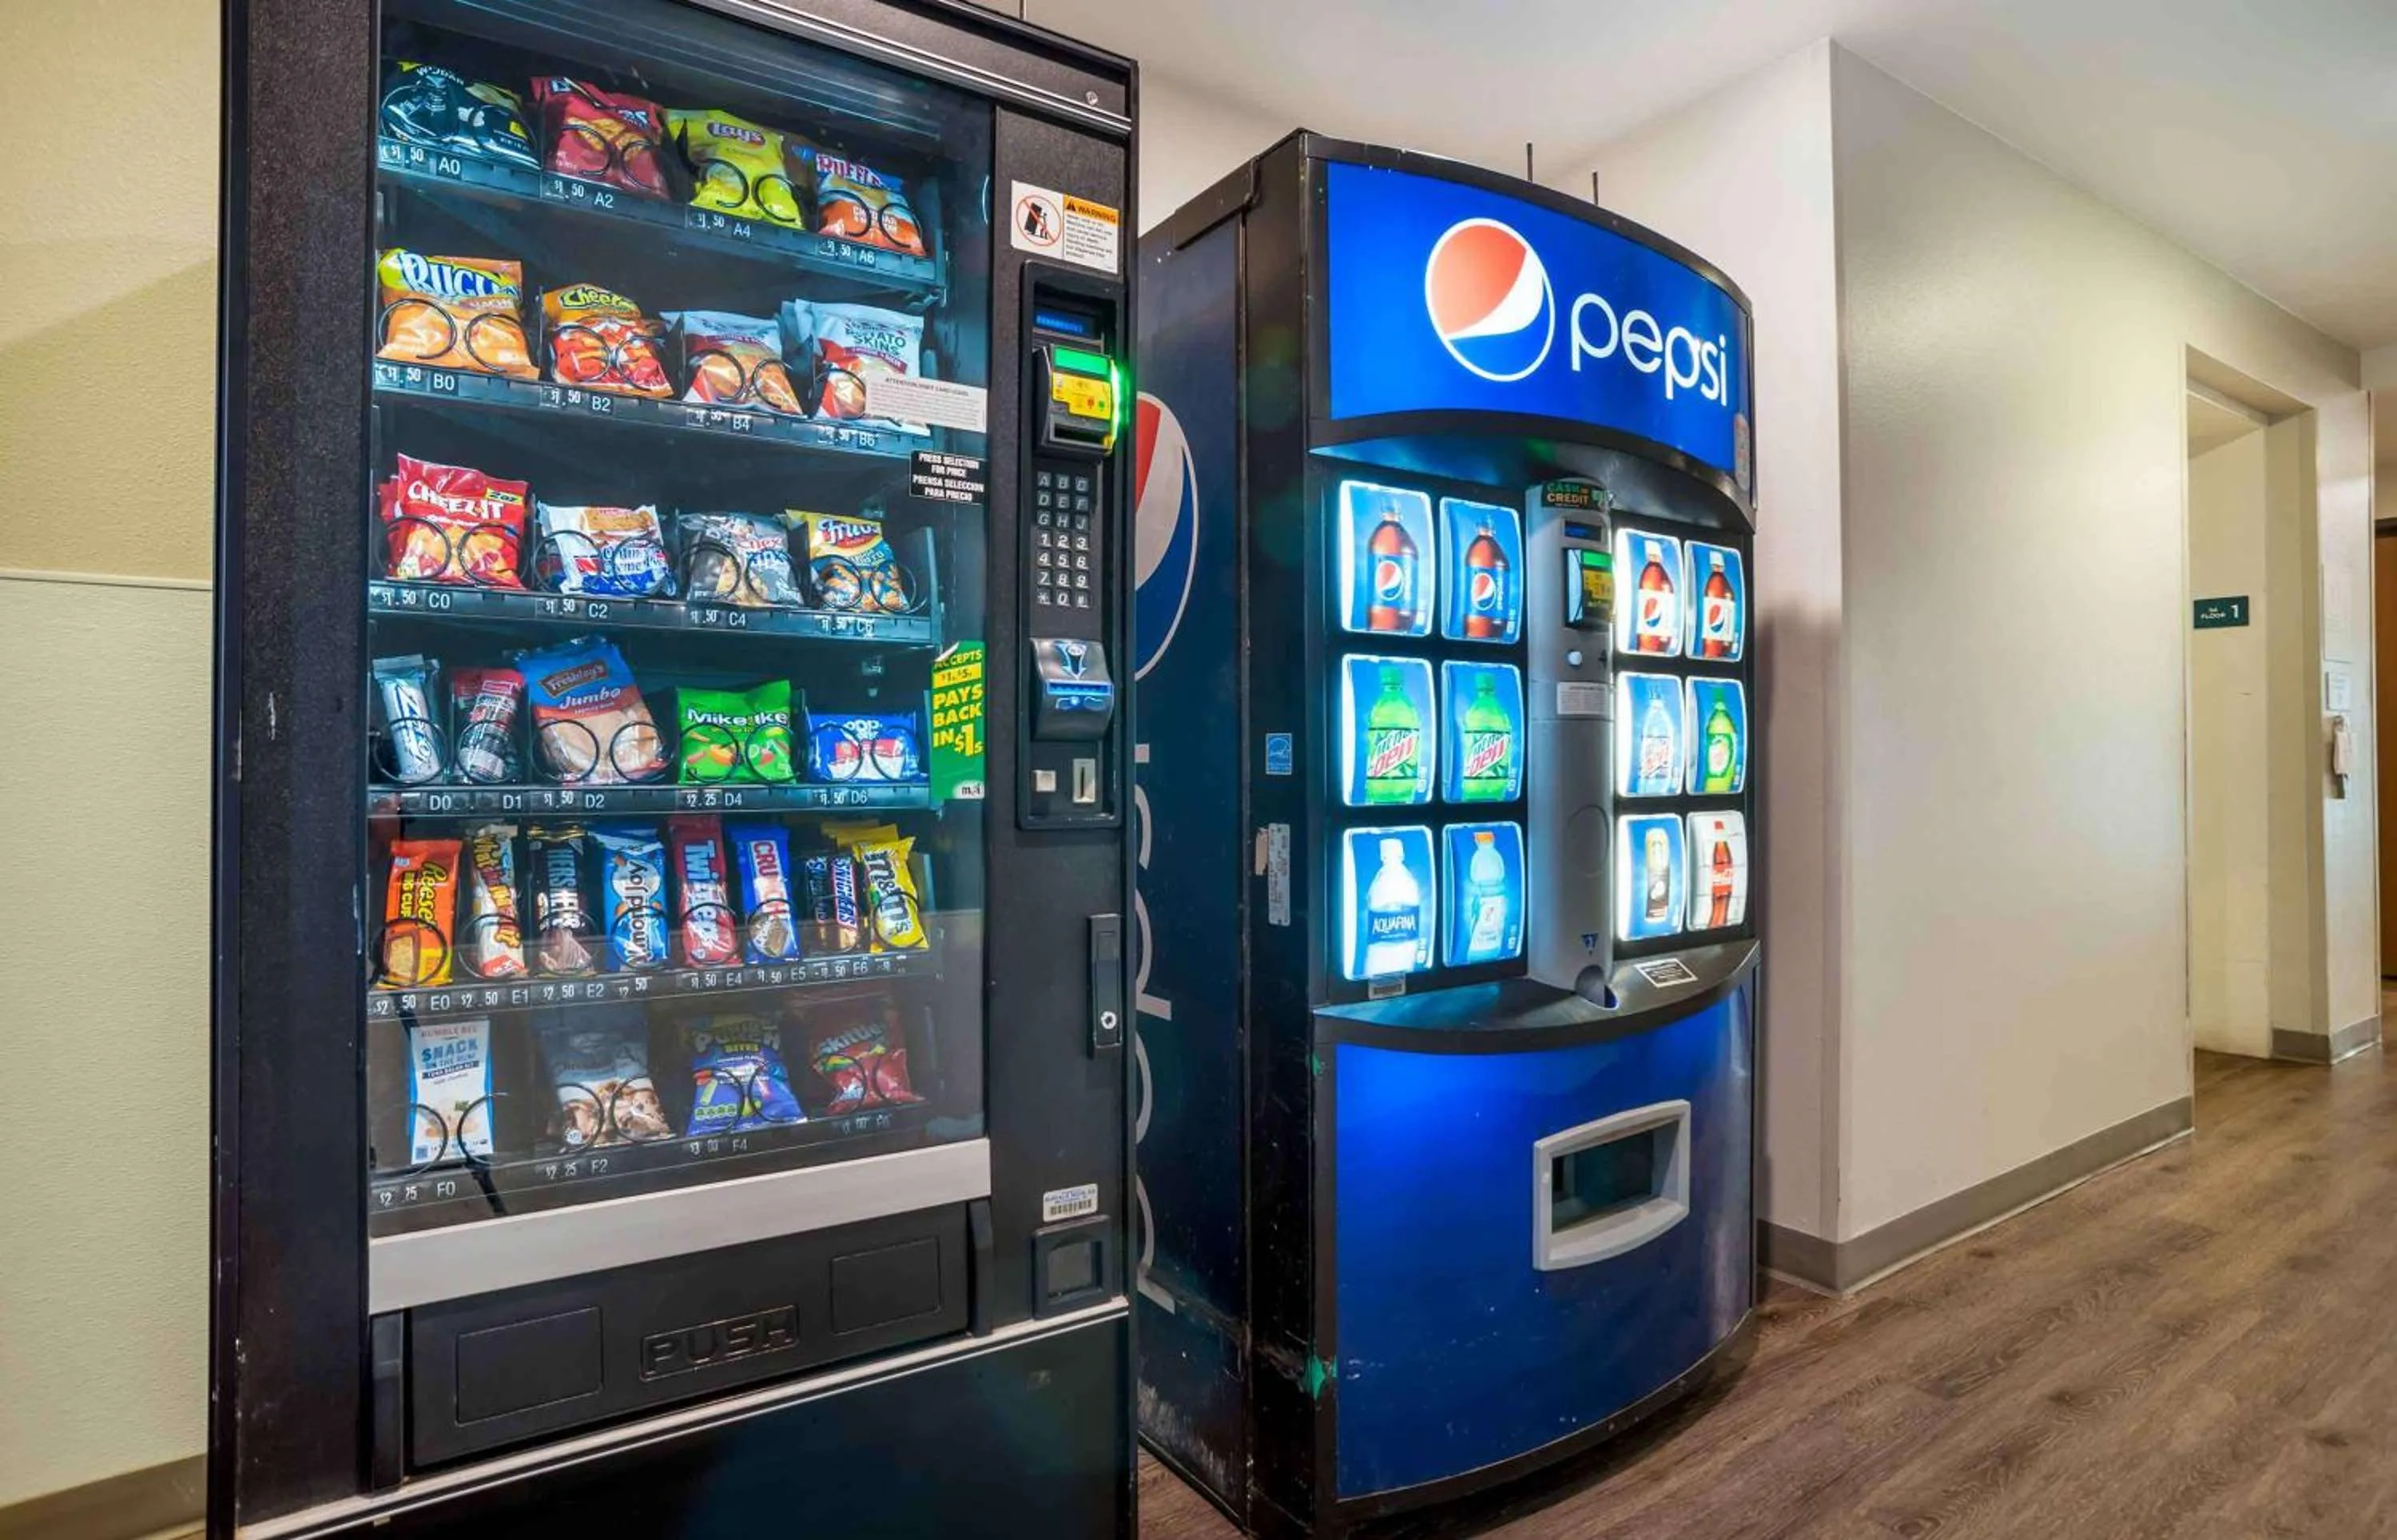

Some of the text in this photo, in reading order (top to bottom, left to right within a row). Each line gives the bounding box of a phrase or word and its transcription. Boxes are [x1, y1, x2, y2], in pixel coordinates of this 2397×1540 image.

[439, 157, 460, 175] A0
[595, 192, 614, 208] A2
[1079, 205, 1116, 224] WARNING
[733, 226, 751, 238] A4
[859, 251, 875, 264] A6
[853, 335, 901, 356] SKINS
[1571, 293, 1727, 407] pepsi
[434, 375, 455, 391] B0
[592, 398, 610, 412] B2
[733, 417, 750, 431] B4
[860, 431, 876, 447] B6
[919, 453, 980, 470] PRESS SELECTION
[931, 465, 967, 478] FOR PRICE
[912, 474, 943, 486] PRENSA
[1039, 475, 1047, 486] A
[1059, 478, 1067, 490] B
[924, 487, 972, 502] PARA PRECIO
[1039, 494, 1048, 505] D
[1059, 497, 1068, 507] E
[1547, 493, 1588, 506] CREDIT
[1039, 514, 1086, 529] G H J
[429, 593, 450, 609] C0
[589, 602, 608, 618] C2
[2230, 605, 2238, 618] 1
[729, 613, 746, 626] C4
[559, 686, 621, 710] Jumbo
[933, 684, 983, 709] PAYS
[688, 708, 746, 725] Mike
[933, 703, 983, 728] BACK
[933, 728, 955, 748] IN
[430, 795, 451, 810] D0
[503, 795, 522, 809] D1
[586, 795, 605, 809] D2
[725, 793, 742, 806] D4
[851, 790, 868, 804] D6
[791, 967, 806, 981] E5
[853, 962, 869, 975] E6
[726, 973, 742, 986] E4
[512, 990, 529, 1005] E1
[587, 984, 604, 998] E2
[431, 994, 450, 1010] E0
[422, 1038, 478, 1062] SNACK
[733, 1139, 748, 1152] F4
[591, 1158, 608, 1174] F2
[437, 1181, 456, 1197] F0
[643, 1310, 793, 1375] PUSH
